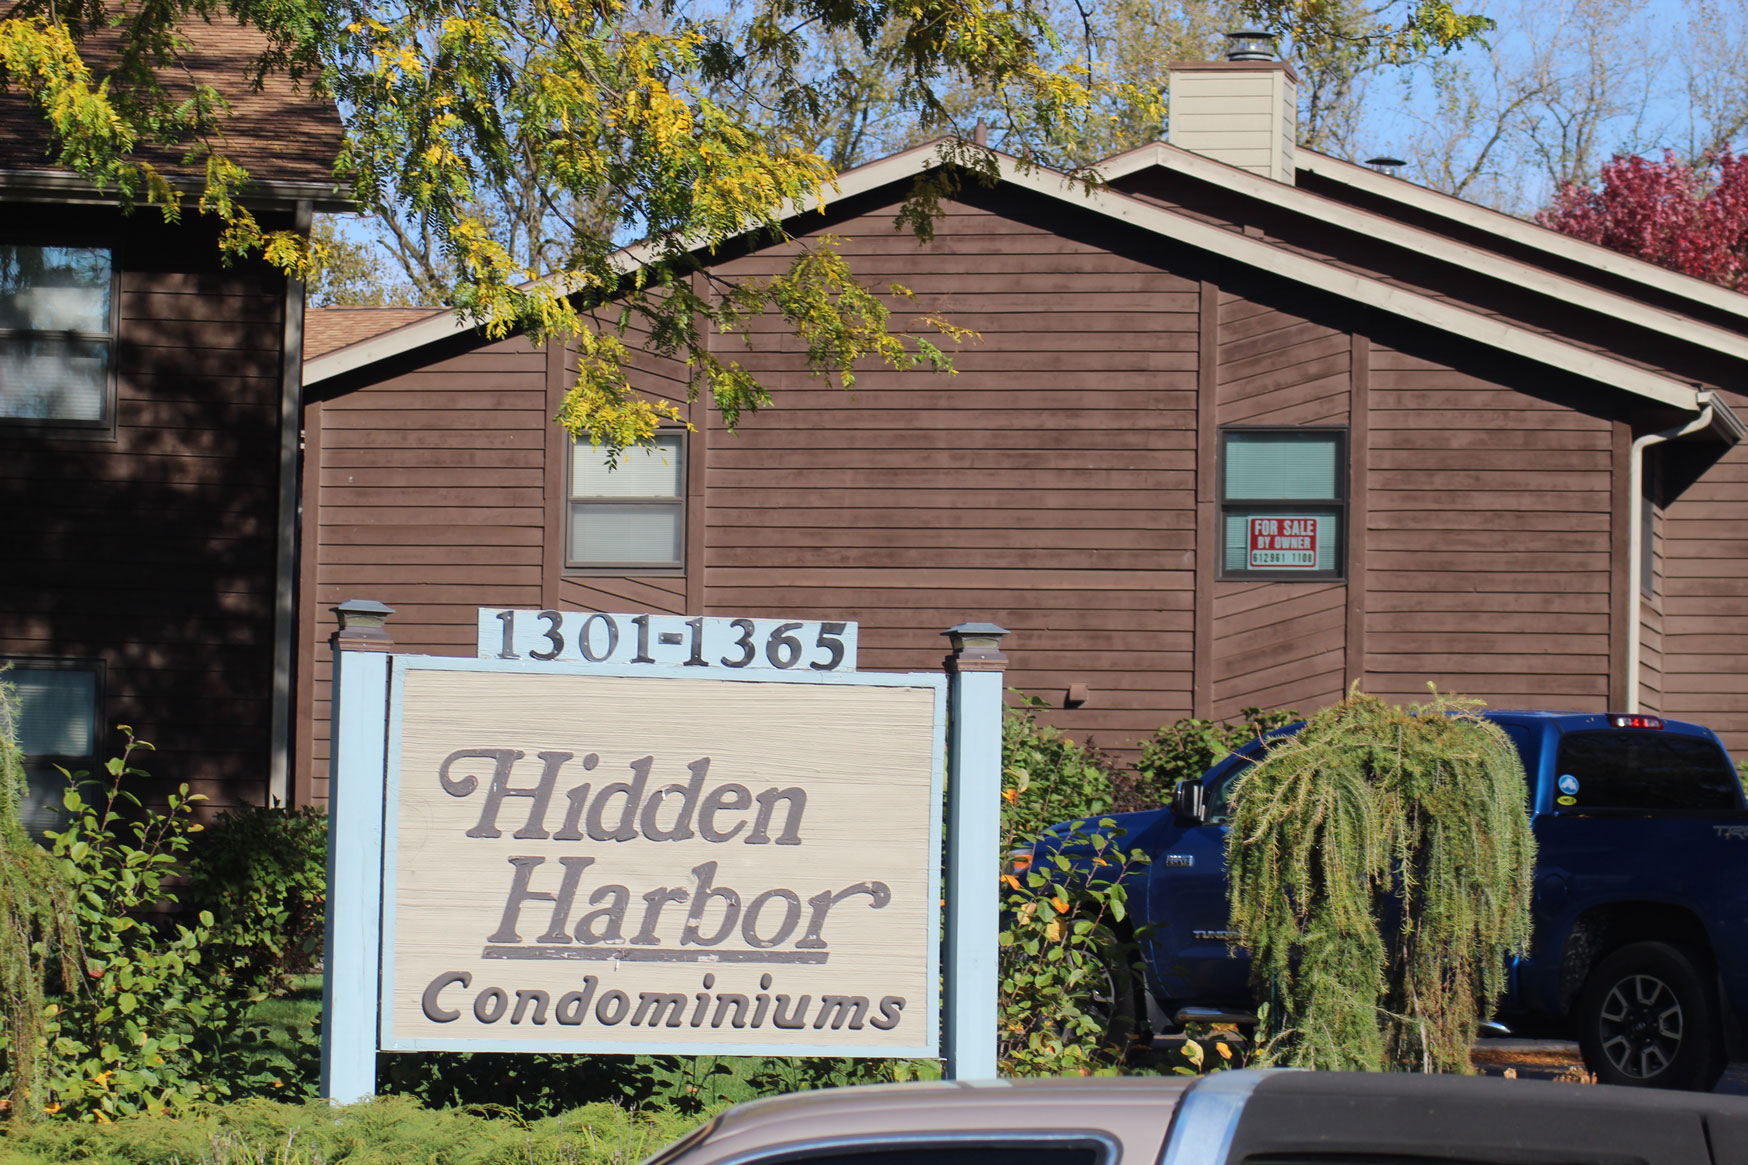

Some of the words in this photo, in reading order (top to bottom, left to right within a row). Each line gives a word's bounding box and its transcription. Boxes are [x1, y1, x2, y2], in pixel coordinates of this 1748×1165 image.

[1254, 519, 1279, 536] FOR
[1282, 519, 1315, 536] SALE
[1257, 536, 1271, 549] BY
[1274, 536, 1312, 549] OWNER
[496, 609, 848, 672] 1301-1365
[439, 748, 808, 847] Hidden
[486, 855, 892, 948] Harbor
[421, 970, 906, 1031] Condominiums
